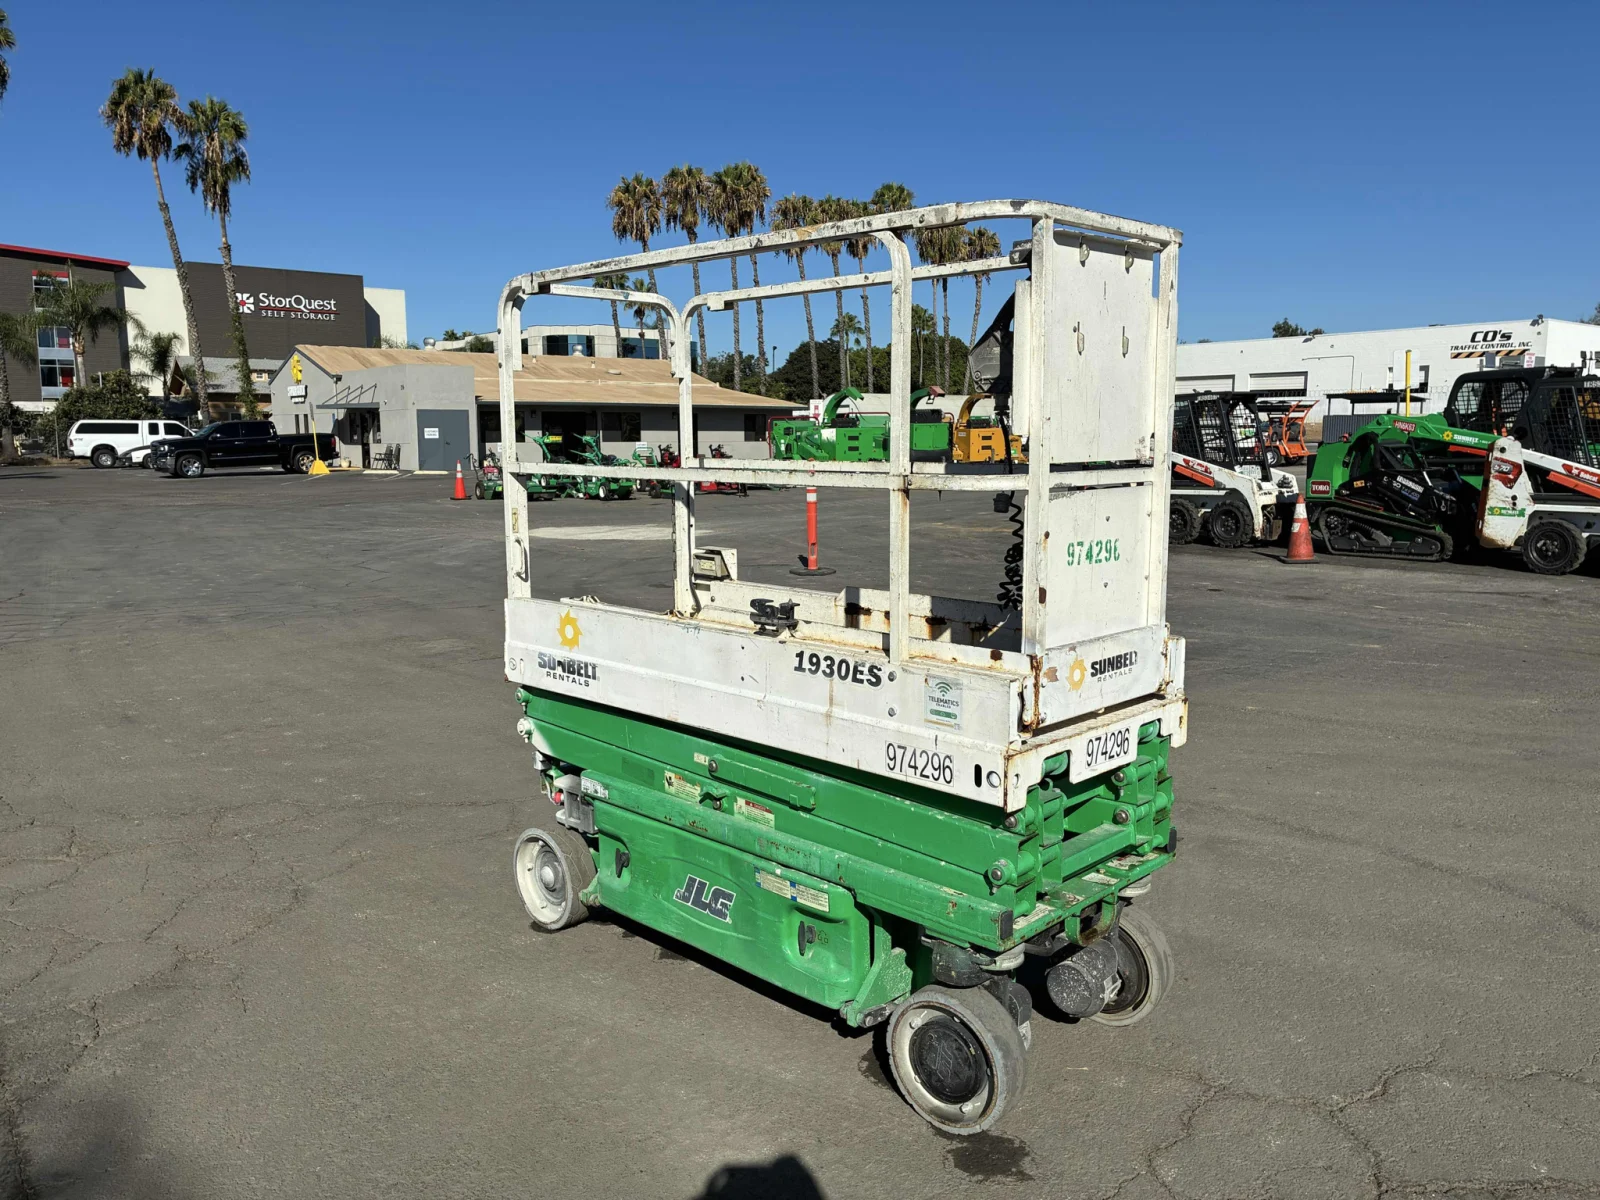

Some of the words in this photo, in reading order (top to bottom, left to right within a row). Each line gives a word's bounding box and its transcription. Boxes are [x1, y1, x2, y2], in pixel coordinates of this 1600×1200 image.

[259, 292, 336, 312] StorQuest
[261, 310, 286, 318] SELF
[291, 311, 336, 321] STORAGE
[1470, 330, 1513, 343] CO's
[1579, 471, 1598, 482] Bobcat
[1067, 538, 1120, 566] 974296
[793, 650, 882, 687] 1930ES
[1097, 667, 1133, 683] RENTALS
[546, 671, 590, 687] RENTALS
[928, 695, 960, 707] TELEMATICS
[1086, 728, 1130, 767] 974296
[886, 743, 953, 785] 974296
[673, 874, 736, 922] JLG
